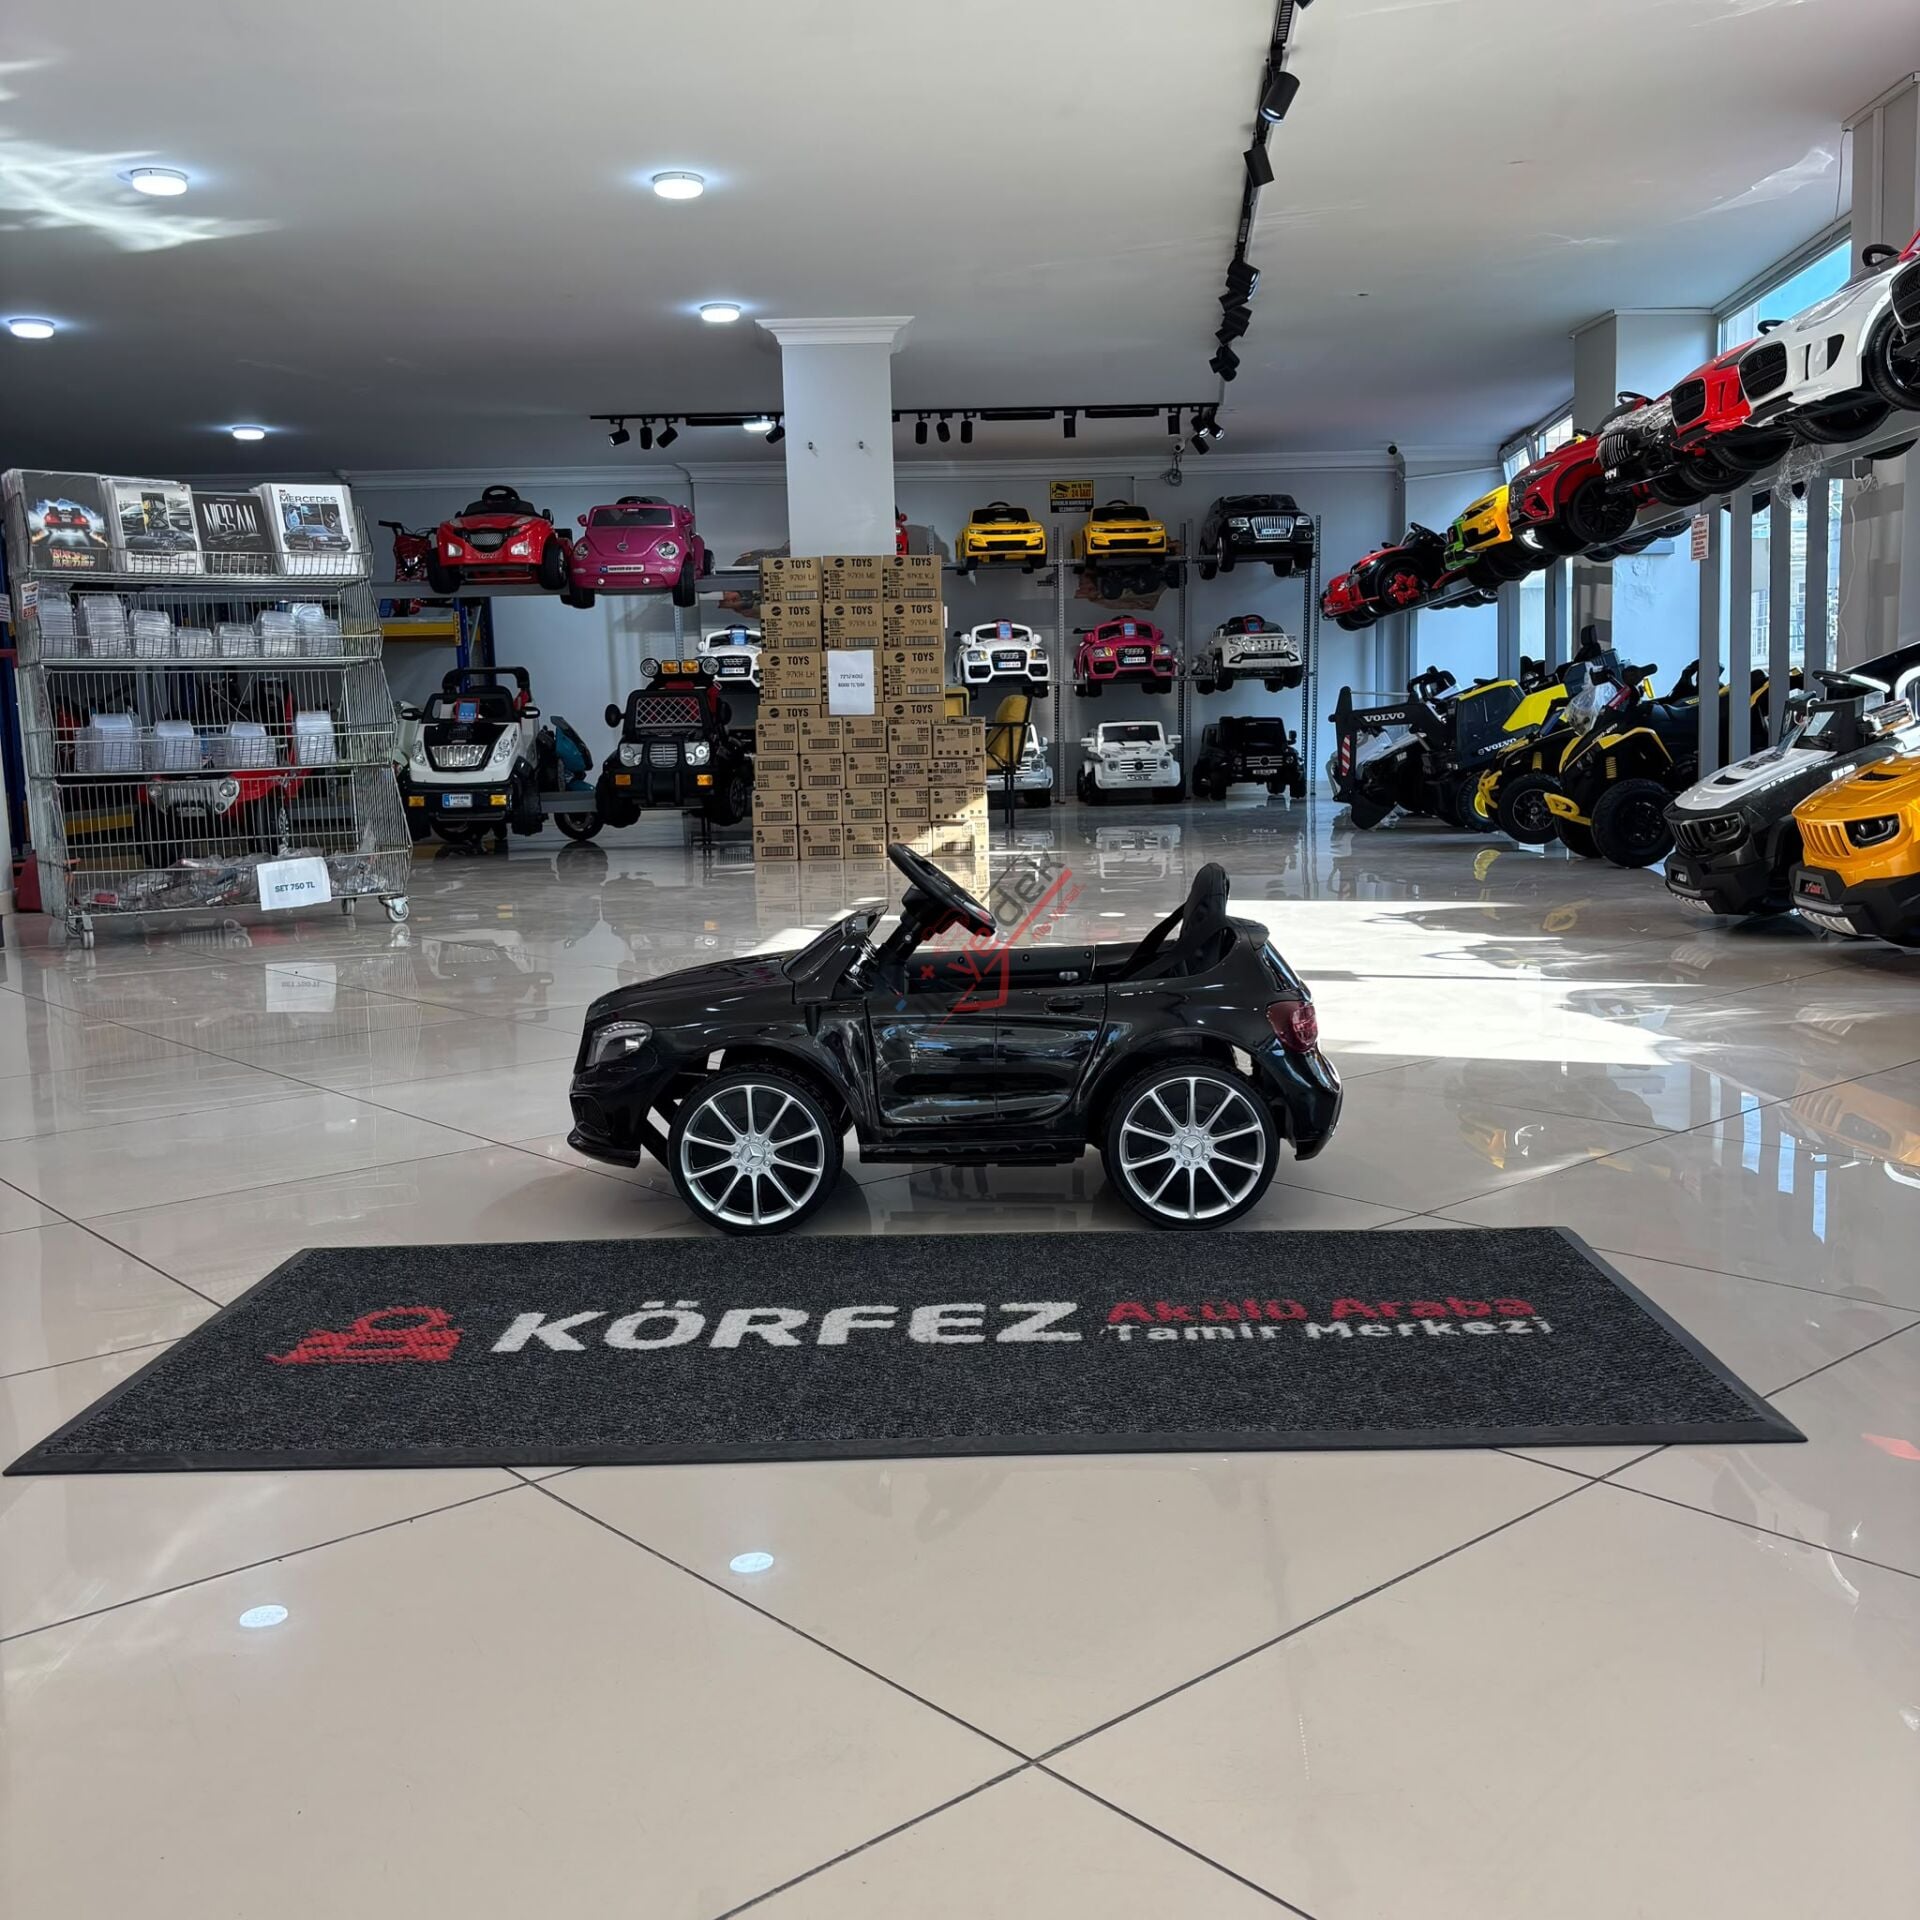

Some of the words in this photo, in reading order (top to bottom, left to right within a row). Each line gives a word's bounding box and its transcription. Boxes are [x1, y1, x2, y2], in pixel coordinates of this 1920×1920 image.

[202, 503, 258, 534] NISSAN
[790, 560, 812, 568] TOYS
[852, 558, 872, 568] TOYS
[911, 558, 932, 566] TOYS
[788, 606, 810, 616] TOYS
[852, 606, 872, 615] TOYS
[912, 604, 933, 614] TOYS
[787, 656, 810, 666] TOYS
[912, 652, 934, 662] TOYS
[786, 708, 808, 718] TOYS
[911, 704, 933, 714] TOYS
[1364, 712, 1406, 722] VOLVO
[1484, 738, 1517, 752] VOLVO
[274, 884, 289, 892] SET
[1331, 1297, 1536, 1320] Araba
[490, 1300, 1082, 1351] KÖRFEZ
[1107, 1323, 1282, 1341] Tamir
[1305, 1316, 1553, 1339] Merkezi
